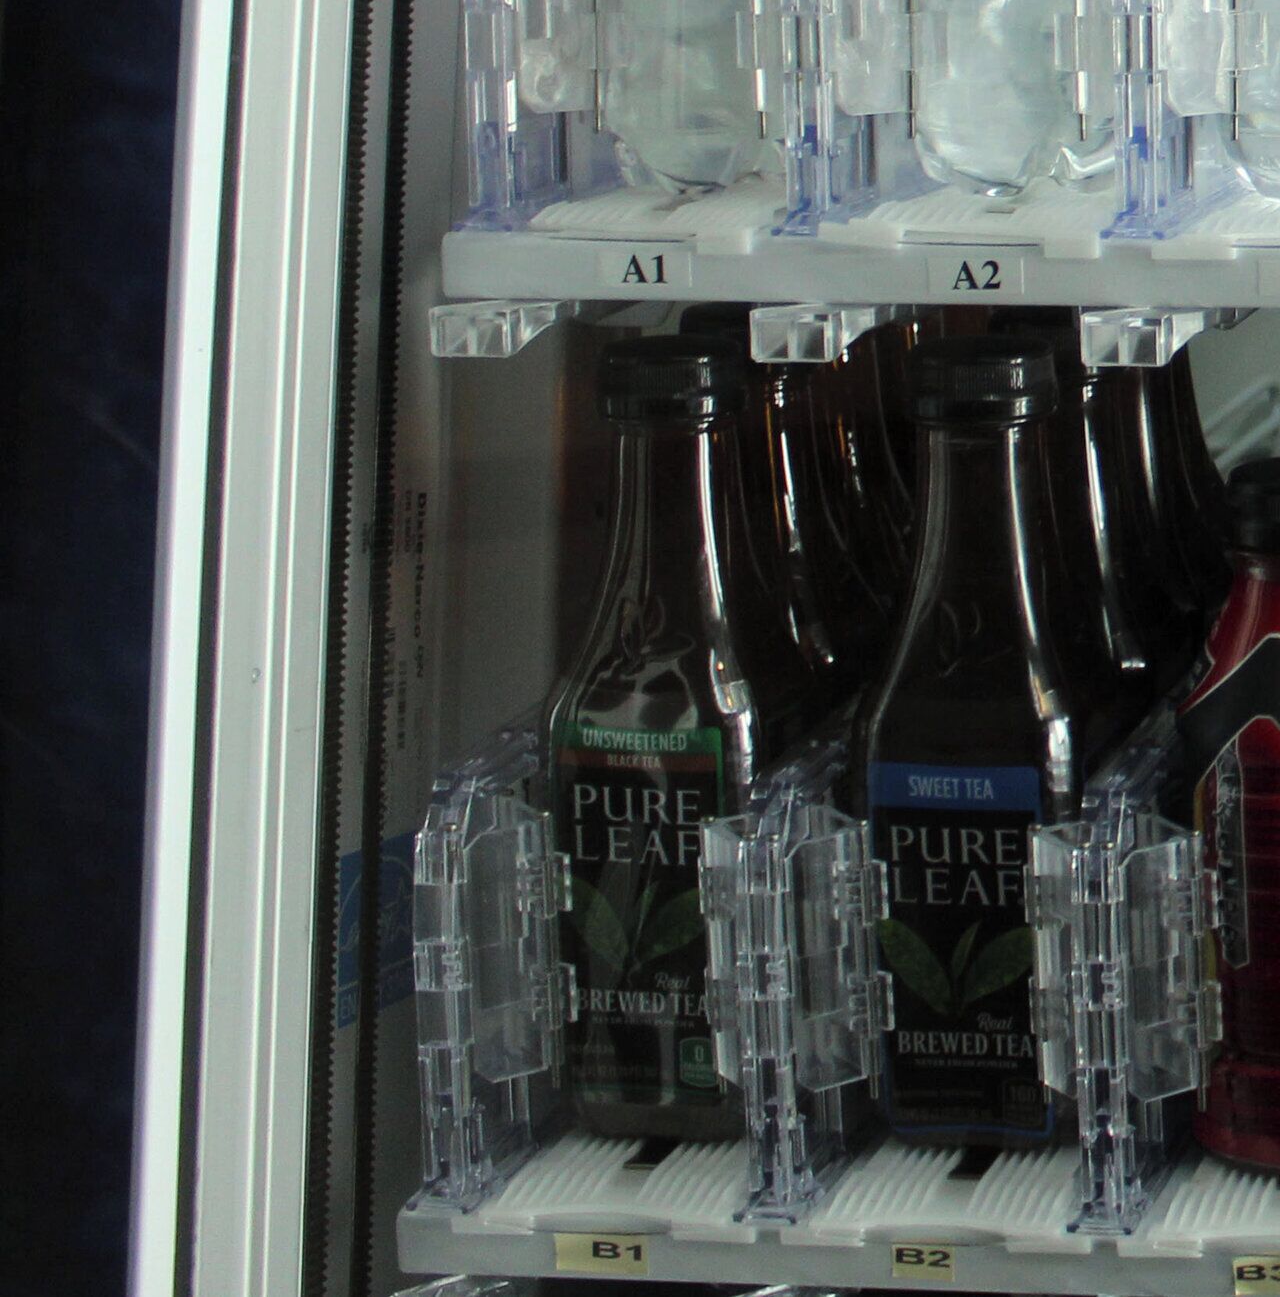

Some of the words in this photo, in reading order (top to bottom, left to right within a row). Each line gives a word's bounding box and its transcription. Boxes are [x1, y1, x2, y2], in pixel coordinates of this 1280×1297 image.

[621, 254, 669, 284] A1
[953, 260, 1001, 291] A2
[582, 727, 688, 752] UNSWEETENED
[607, 754, 640, 767] BLACK
[642, 756, 661, 768] TEA
[908, 775, 959, 799] SWEET
[963, 777, 994, 800] TEA
[573, 783, 700, 826] PURE
[575, 824, 700, 866] LEAF
[888, 824, 1021, 866] PURE
[892, 864, 1023, 907] LEAF
[898, 1030, 988, 1056] BREWED
[991, 1033, 1034, 1058] TEA
[592, 1241, 642, 1262] B1
[895, 1247, 950, 1268] B2
